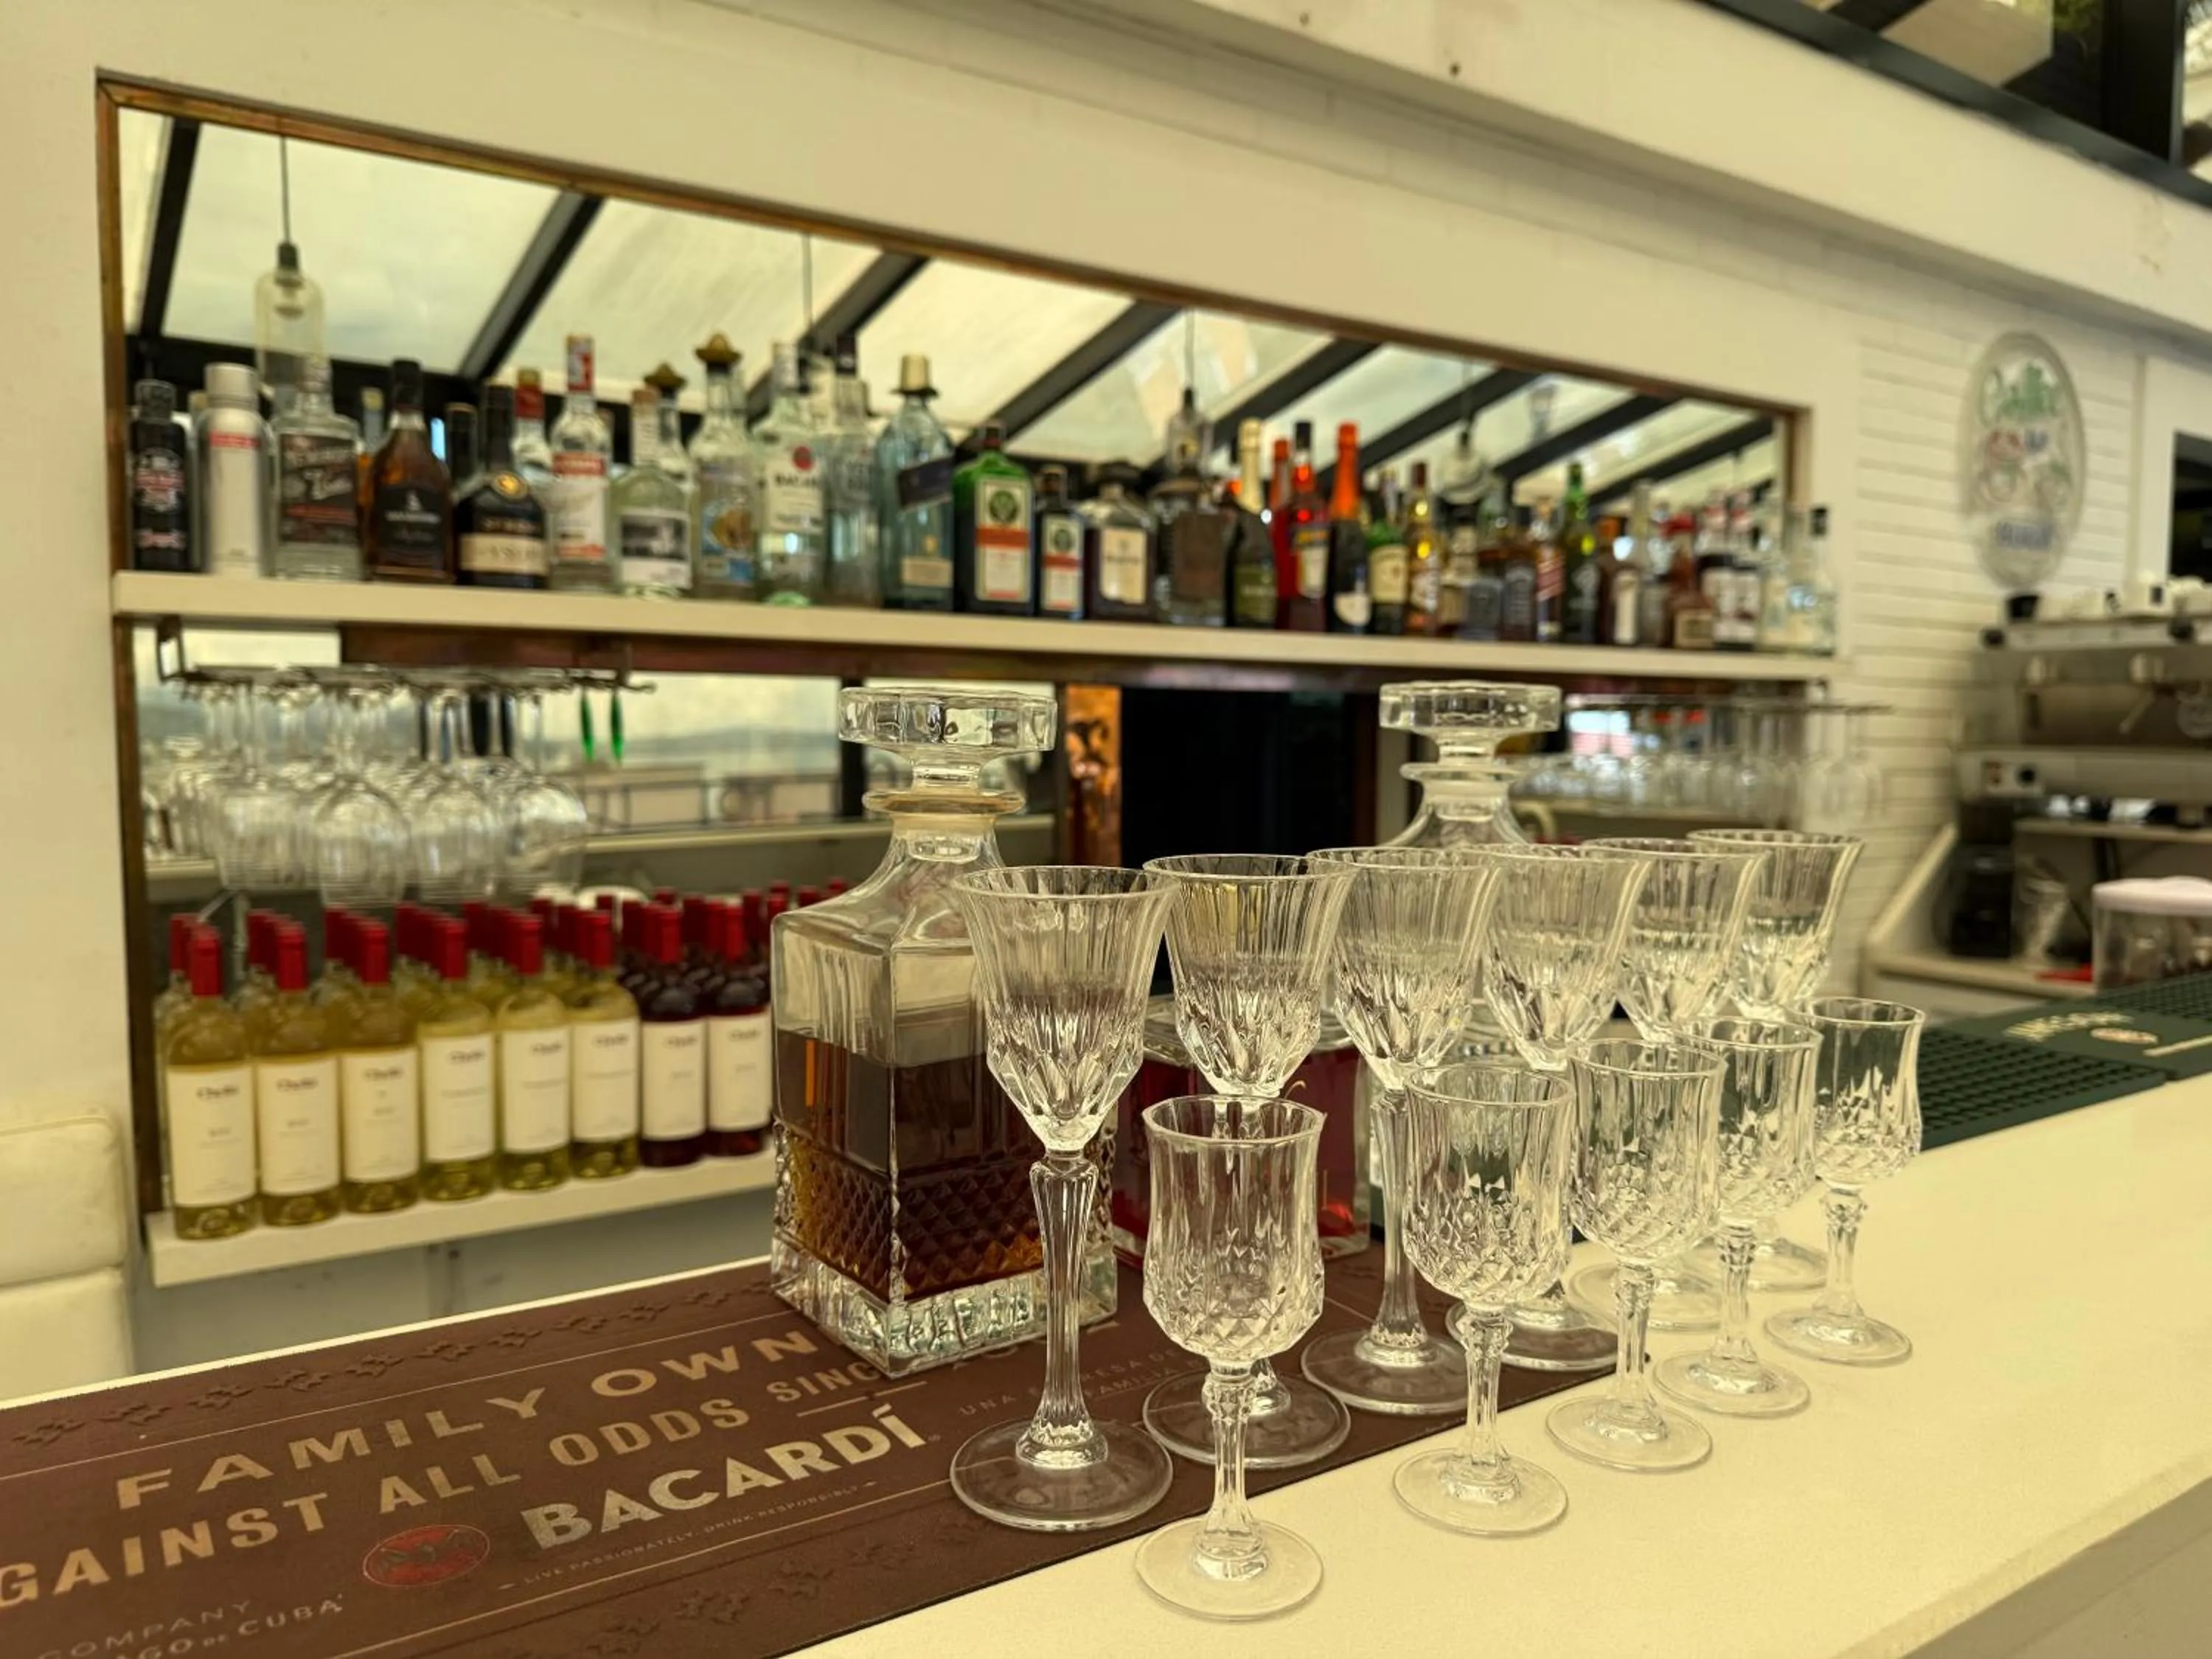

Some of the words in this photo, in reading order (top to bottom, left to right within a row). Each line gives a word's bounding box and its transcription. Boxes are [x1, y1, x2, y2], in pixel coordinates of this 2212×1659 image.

[0, 1493, 327, 1608] GAINST
[379, 1453, 521, 1513] ALL
[549, 1398, 750, 1466] ODDS
[767, 1361, 880, 1402] SINC
[116, 1388, 546, 1509] FAMILY
[591, 1331, 818, 1397] OWN
[521, 1403, 927, 1549] BACARDÍ
